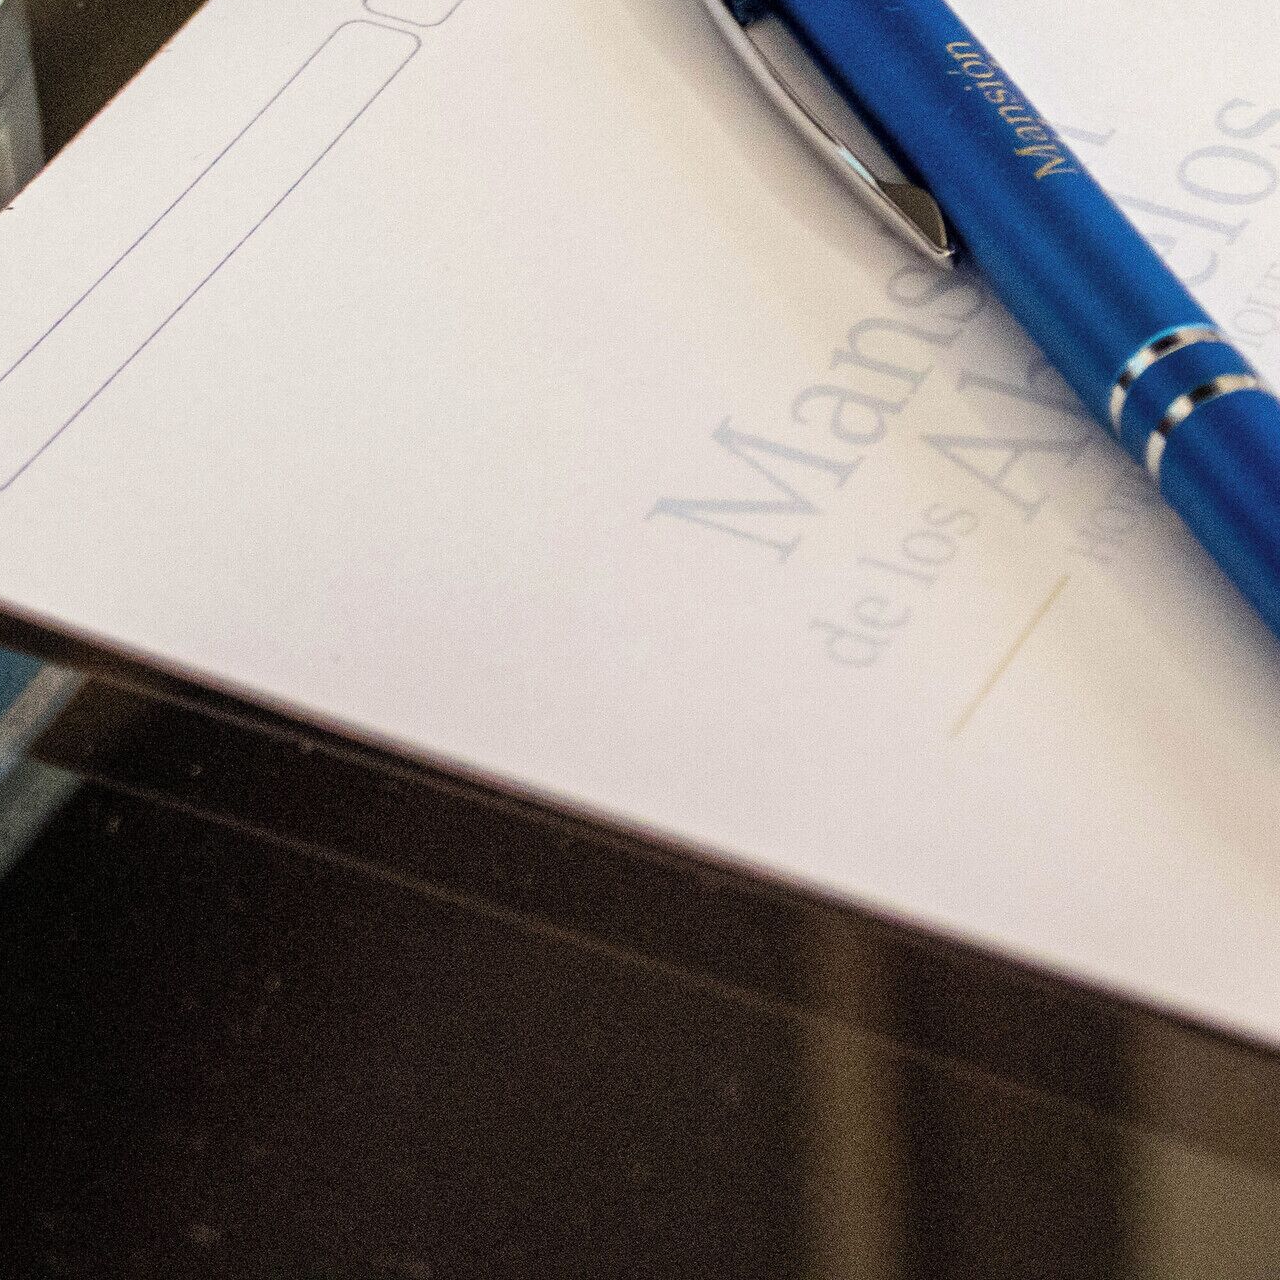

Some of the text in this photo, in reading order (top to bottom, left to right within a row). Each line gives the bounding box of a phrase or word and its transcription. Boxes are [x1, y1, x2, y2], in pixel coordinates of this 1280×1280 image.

[945, 40, 1078, 181] Mansión
[855, 502, 982, 590] los
[806, 594, 912, 669] de
